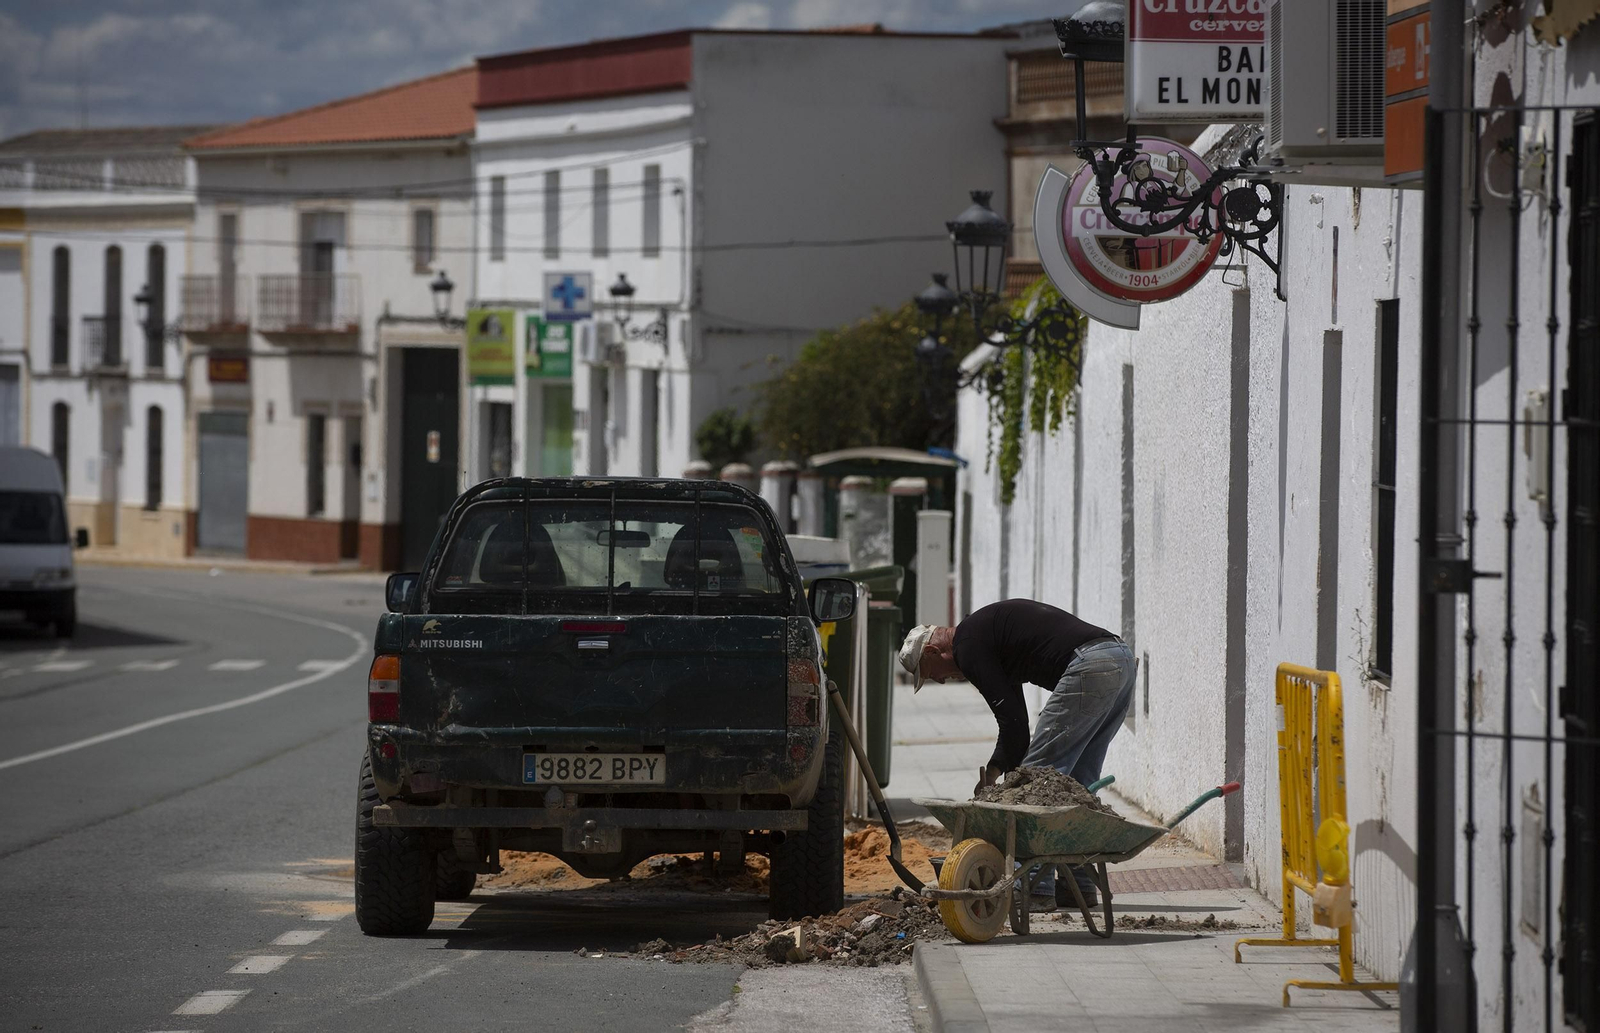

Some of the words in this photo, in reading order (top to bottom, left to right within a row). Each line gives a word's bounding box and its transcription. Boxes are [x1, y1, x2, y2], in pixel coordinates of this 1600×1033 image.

[1217, 45, 1264, 73] BA
[1157, 77, 1188, 104] EL
[1202, 77, 1260, 105] MON
[1106, 265, 1125, 280] BEER
[1128, 274, 1159, 287] 1904
[420, 640, 483, 649] MITSUBISHI
[540, 757, 602, 780] 9882
[612, 757, 658, 780] BPY
